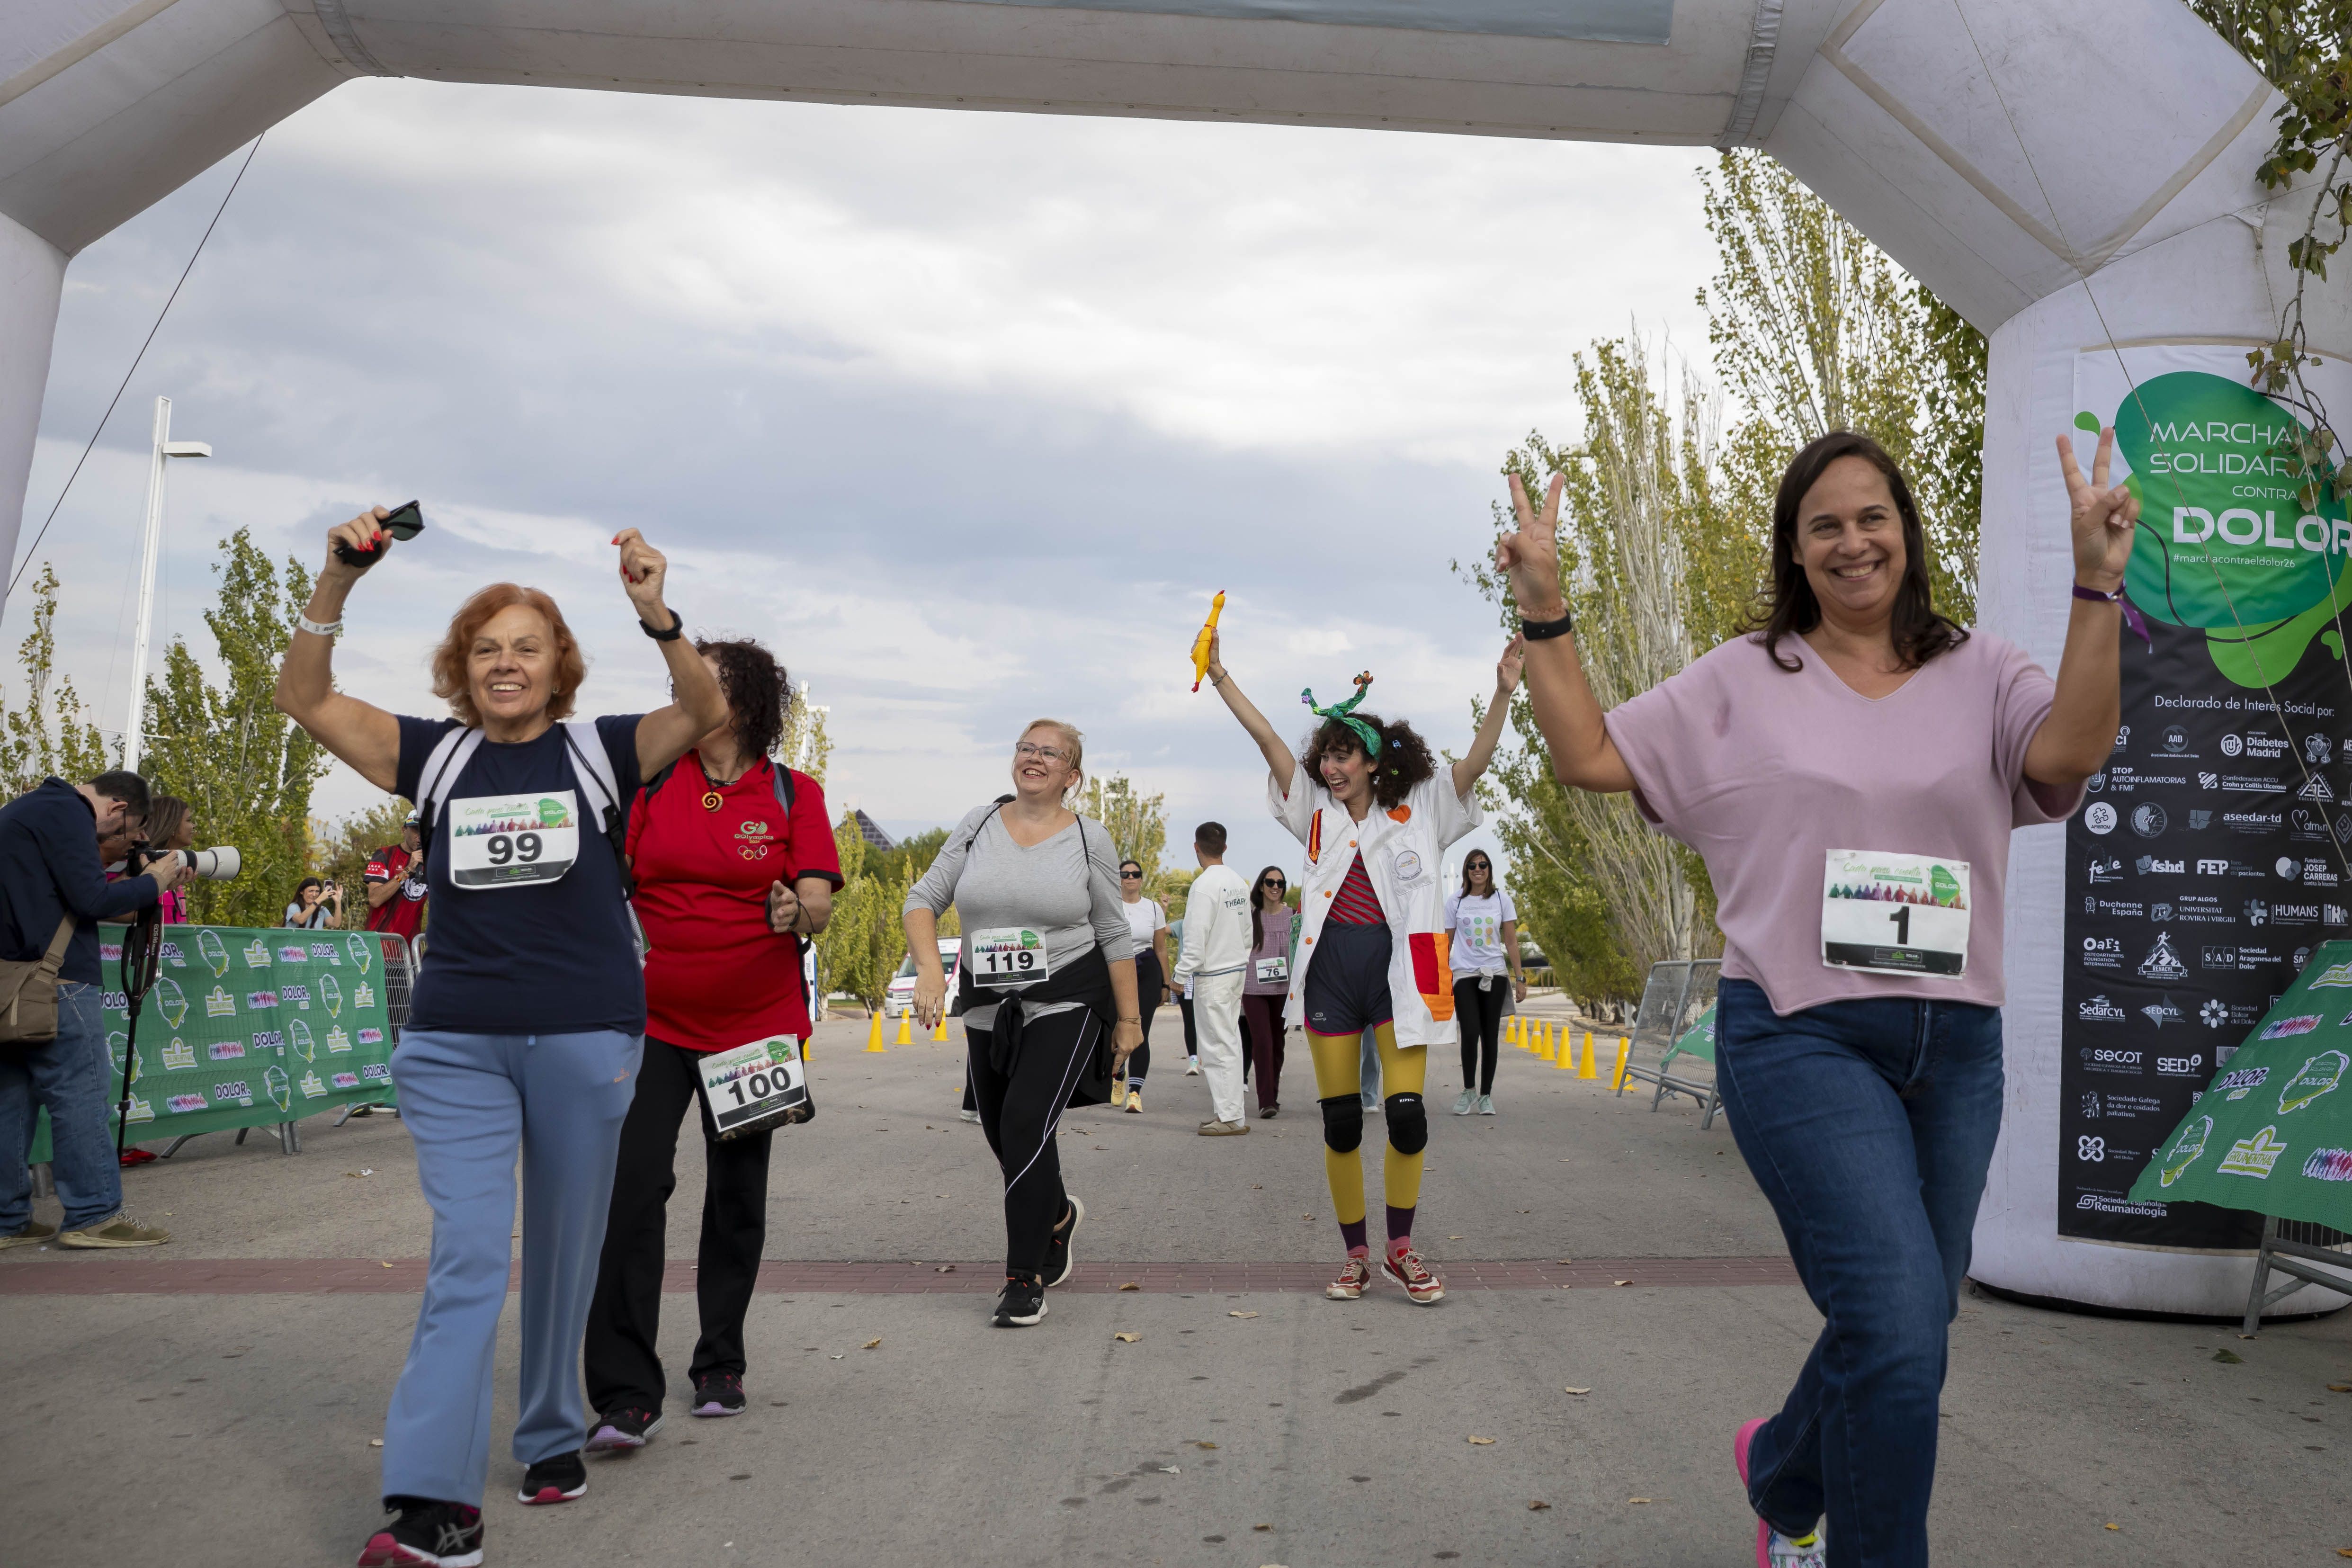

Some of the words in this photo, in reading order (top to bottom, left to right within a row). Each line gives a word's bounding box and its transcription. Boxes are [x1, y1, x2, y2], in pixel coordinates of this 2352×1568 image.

[2149, 421, 2292, 446] MARCHA
[2149, 453, 2316, 482] SOLIDARA
[2232, 485, 2298, 500] CONTRA
[2173, 506, 2352, 558] DOLOR
[2155, 695, 2221, 708] Declarado
[2225, 697, 2240, 709] de
[2245, 698, 2281, 711] Interés
[2284, 700, 2315, 715] Social
[2317, 708, 2334, 718] por:
[2247, 737, 2289, 748] Diabetes
[2247, 748, 2280, 758] Madrid
[2112, 776, 2186, 784] AUTOINFLAMATORIAS
[2223, 812, 2281, 823] aseedar-td
[487, 832, 543, 865] 99
[1843, 862, 1867, 873] Cada
[1894, 866, 1921, 877] cuenta
[2152, 860, 2185, 873] fshd
[2197, 860, 2228, 875] FEP
[2304, 864, 2327, 872] JOSEP
[2304, 873, 2338, 881] CARRERAS
[2100, 900, 2143, 908] Duchenne
[2275, 904, 2318, 917] HUMANS
[2112, 908, 2143, 916] España
[1889, 905, 1910, 945] 1
[986, 951, 1034, 972] 119
[1266, 968, 1279, 977] 76
[2146, 1006, 2179, 1015] SEDCYL
[2157, 1057, 2189, 1073] SED
[728, 1066, 791, 1106] 100
[2095, 1202, 2167, 1218] Reumatología
